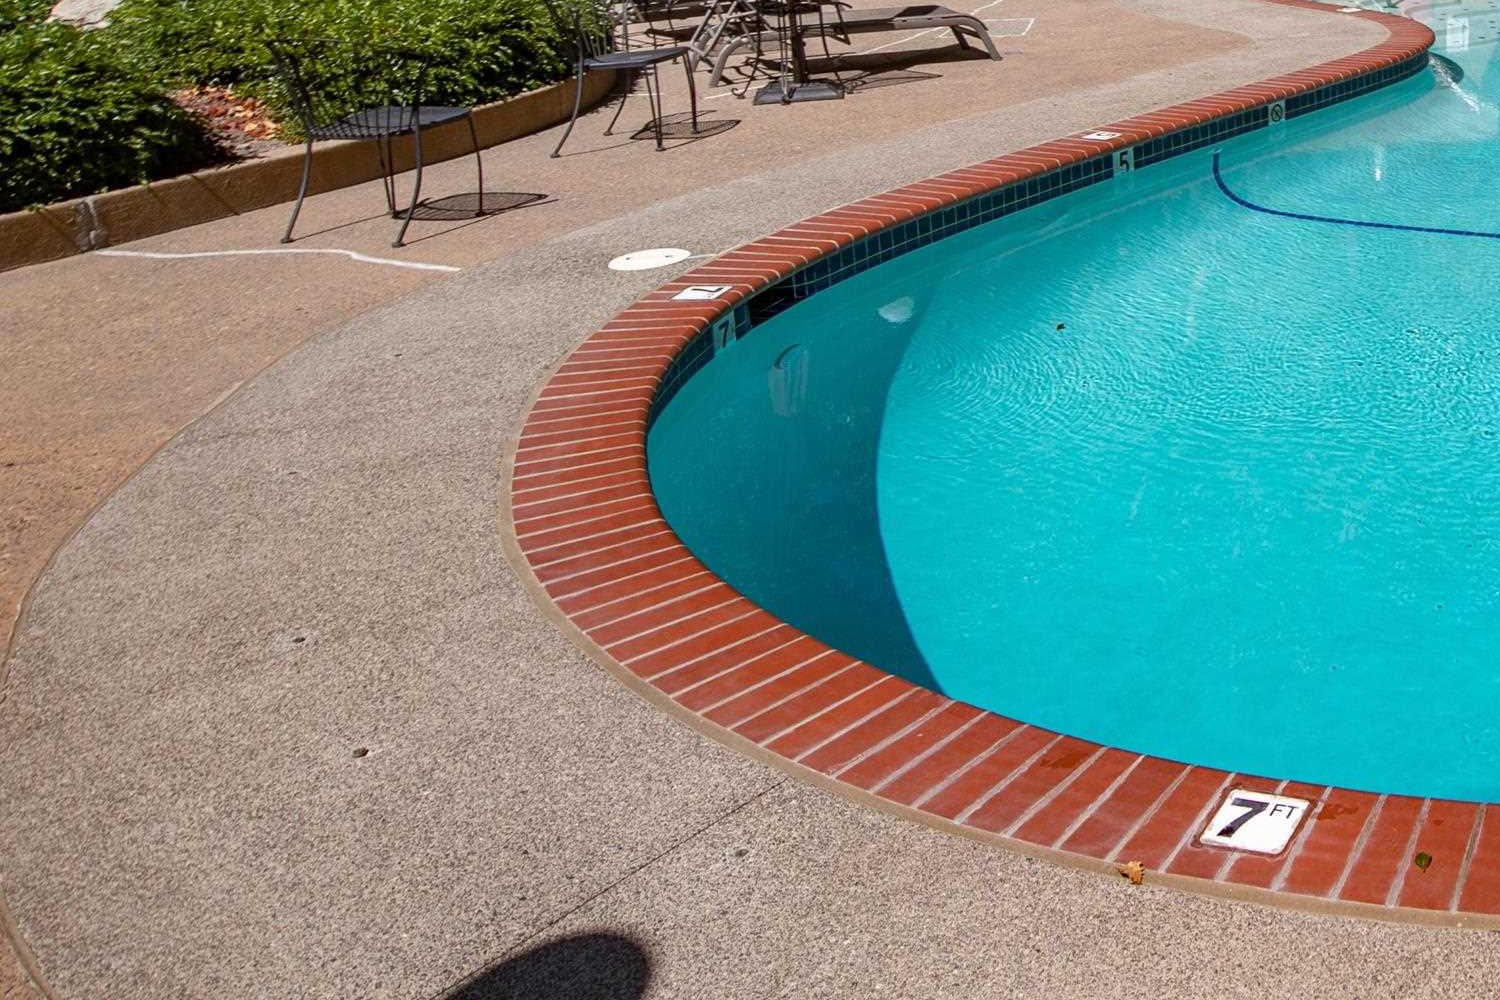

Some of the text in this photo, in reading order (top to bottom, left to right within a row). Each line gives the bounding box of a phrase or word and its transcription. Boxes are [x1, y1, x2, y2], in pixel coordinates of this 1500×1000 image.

[1119, 150, 1130, 173] 5
[718, 319, 731, 349] 7
[1217, 797, 1299, 837] 7 FT
